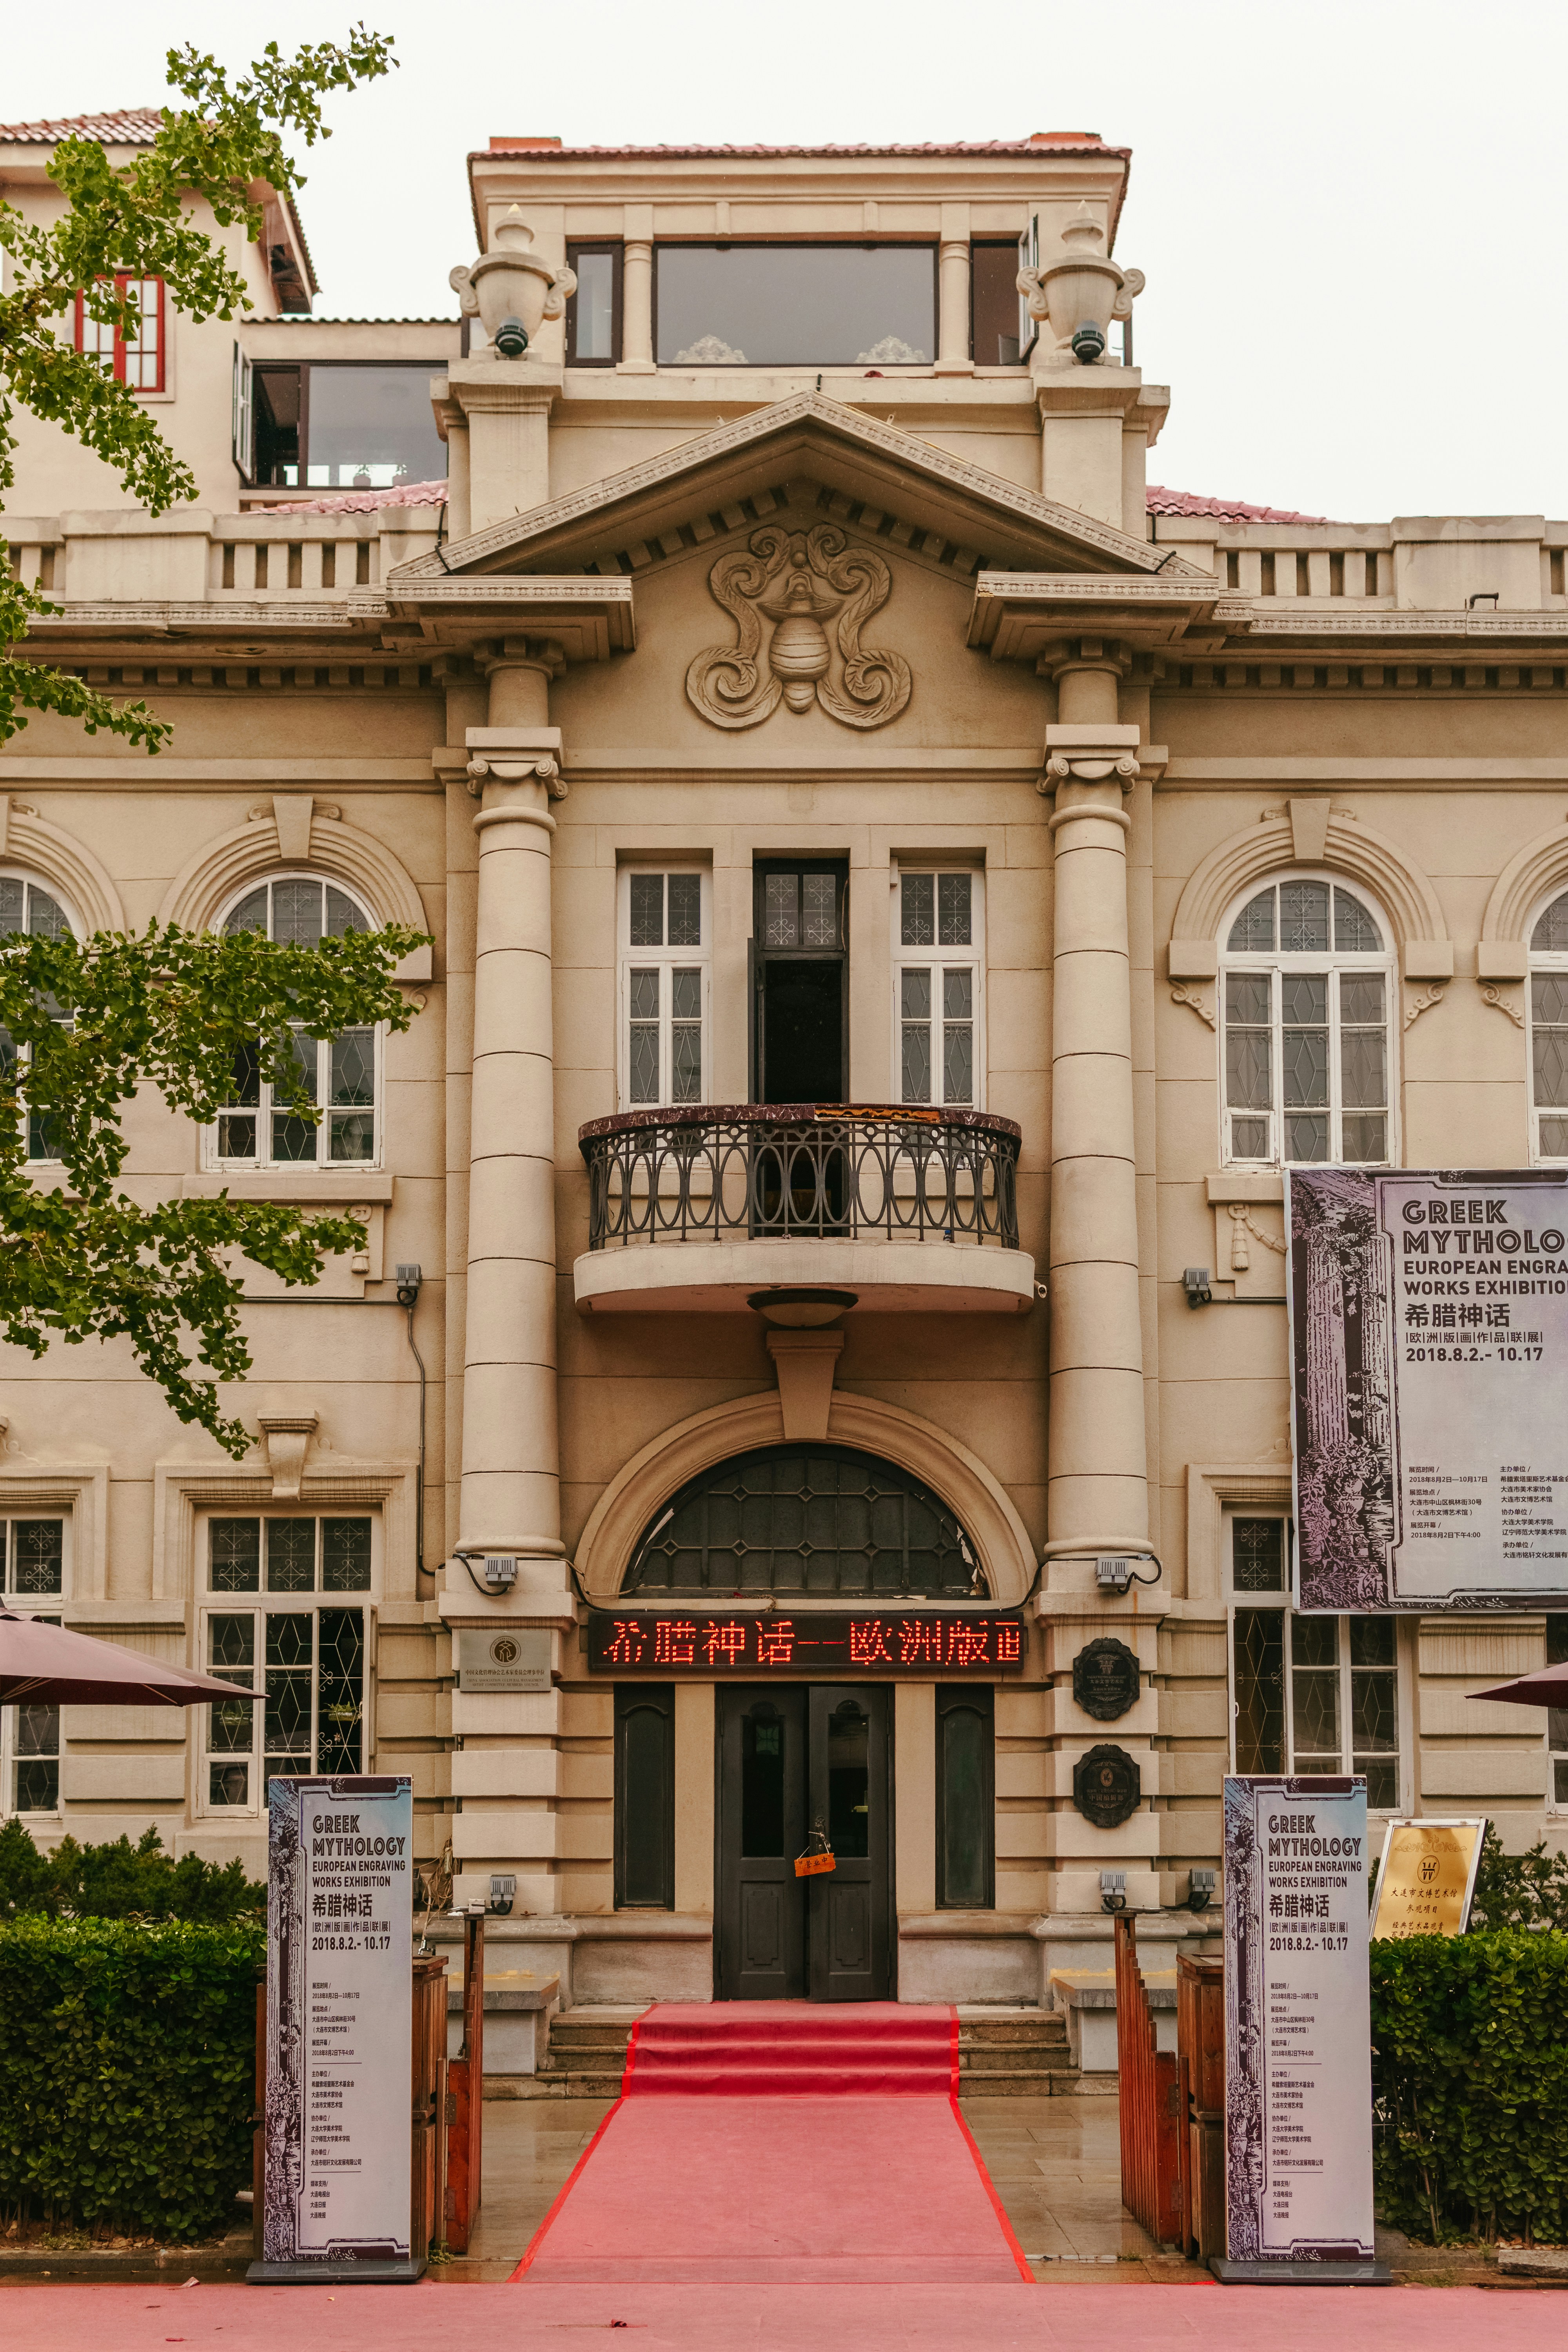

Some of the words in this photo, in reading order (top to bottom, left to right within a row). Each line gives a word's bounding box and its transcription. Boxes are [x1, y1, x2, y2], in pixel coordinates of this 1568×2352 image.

[1402, 1200, 1508, 1224] GREEK
[1403, 1229, 1568, 1254] MYTHOLO
[1404, 1260, 1501, 1274] EUROPEAN
[1404, 1281, 1470, 1295] WORKS
[1476, 1280, 1568, 1294] EXHIBITIO
[1405, 1303, 1510, 1328] 希腊神话
[1406, 1348, 1491, 1361] 2018.8.2.-
[1498, 1347, 1543, 1361] 10.17
[313, 1815, 360, 1833] GREEK
[1269, 1815, 1316, 1833] GREEK
[313, 1837, 405, 1856] MYTHOLOGY
[1269, 1838, 1361, 1856] MYTHOLOGY
[313, 1861, 356, 1872] EUROPEAN
[359, 1860, 405, 1871] ENGRAVING
[805, 1857, 827, 1868] 营业中
[1269, 1861, 1312, 1872] EUROPEAN
[1315, 1861, 1361, 1871] ENGRAVING
[312, 1877, 341, 1887] WORKS
[345, 1876, 390, 1887] EXHIBITION
[1269, 1877, 1298, 1887] WORKS
[1301, 1877, 1347, 1887] EXHIBITION
[1390, 1887, 1457, 1898] 大连市文博艺术馆
[312, 1893, 372, 1917] 希腊神话
[1269, 1894, 1329, 1917] 希腊神话
[312, 1937, 361, 1950] 2018.8.2.-
[365, 1936, 390, 1949] 10.17
[1270, 1937, 1318, 1950] 2018.8.2.-
[1322, 1937, 1347, 1950] 10.17
